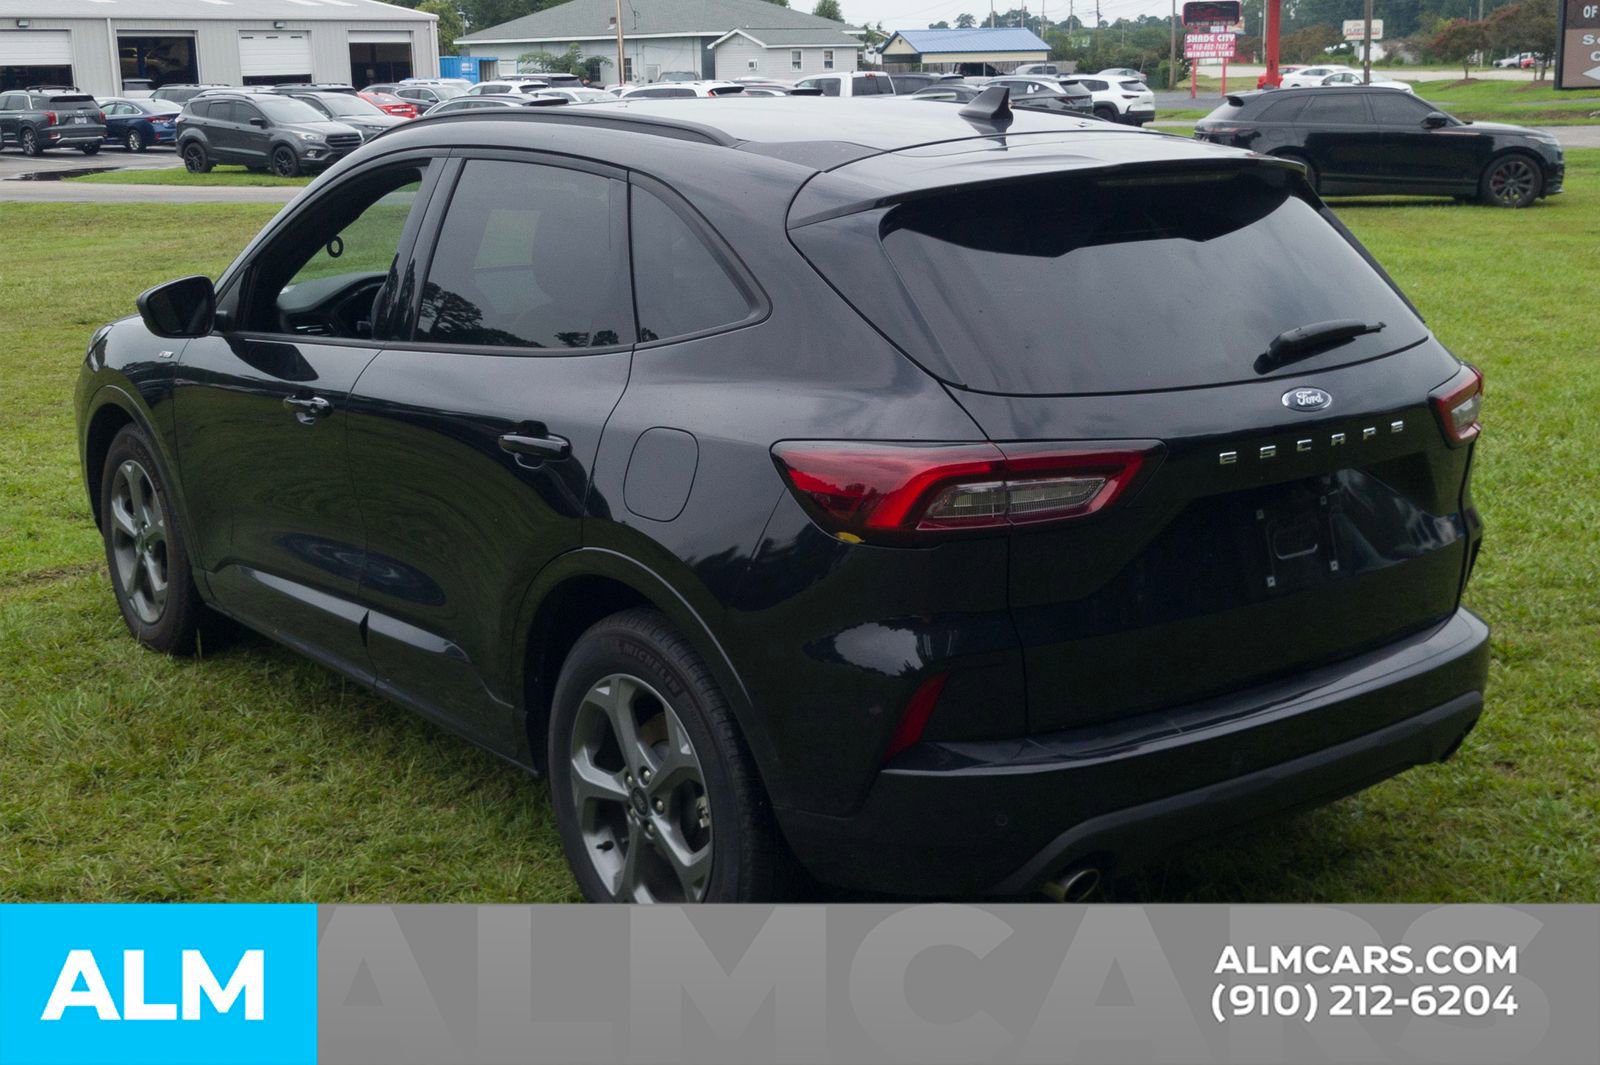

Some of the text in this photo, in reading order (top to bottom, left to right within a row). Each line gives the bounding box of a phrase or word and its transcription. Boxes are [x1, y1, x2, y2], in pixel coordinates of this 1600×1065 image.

[1186, 34, 1235, 43] SHADE CITY
[1219, 420, 1404, 465] ESCAPE
